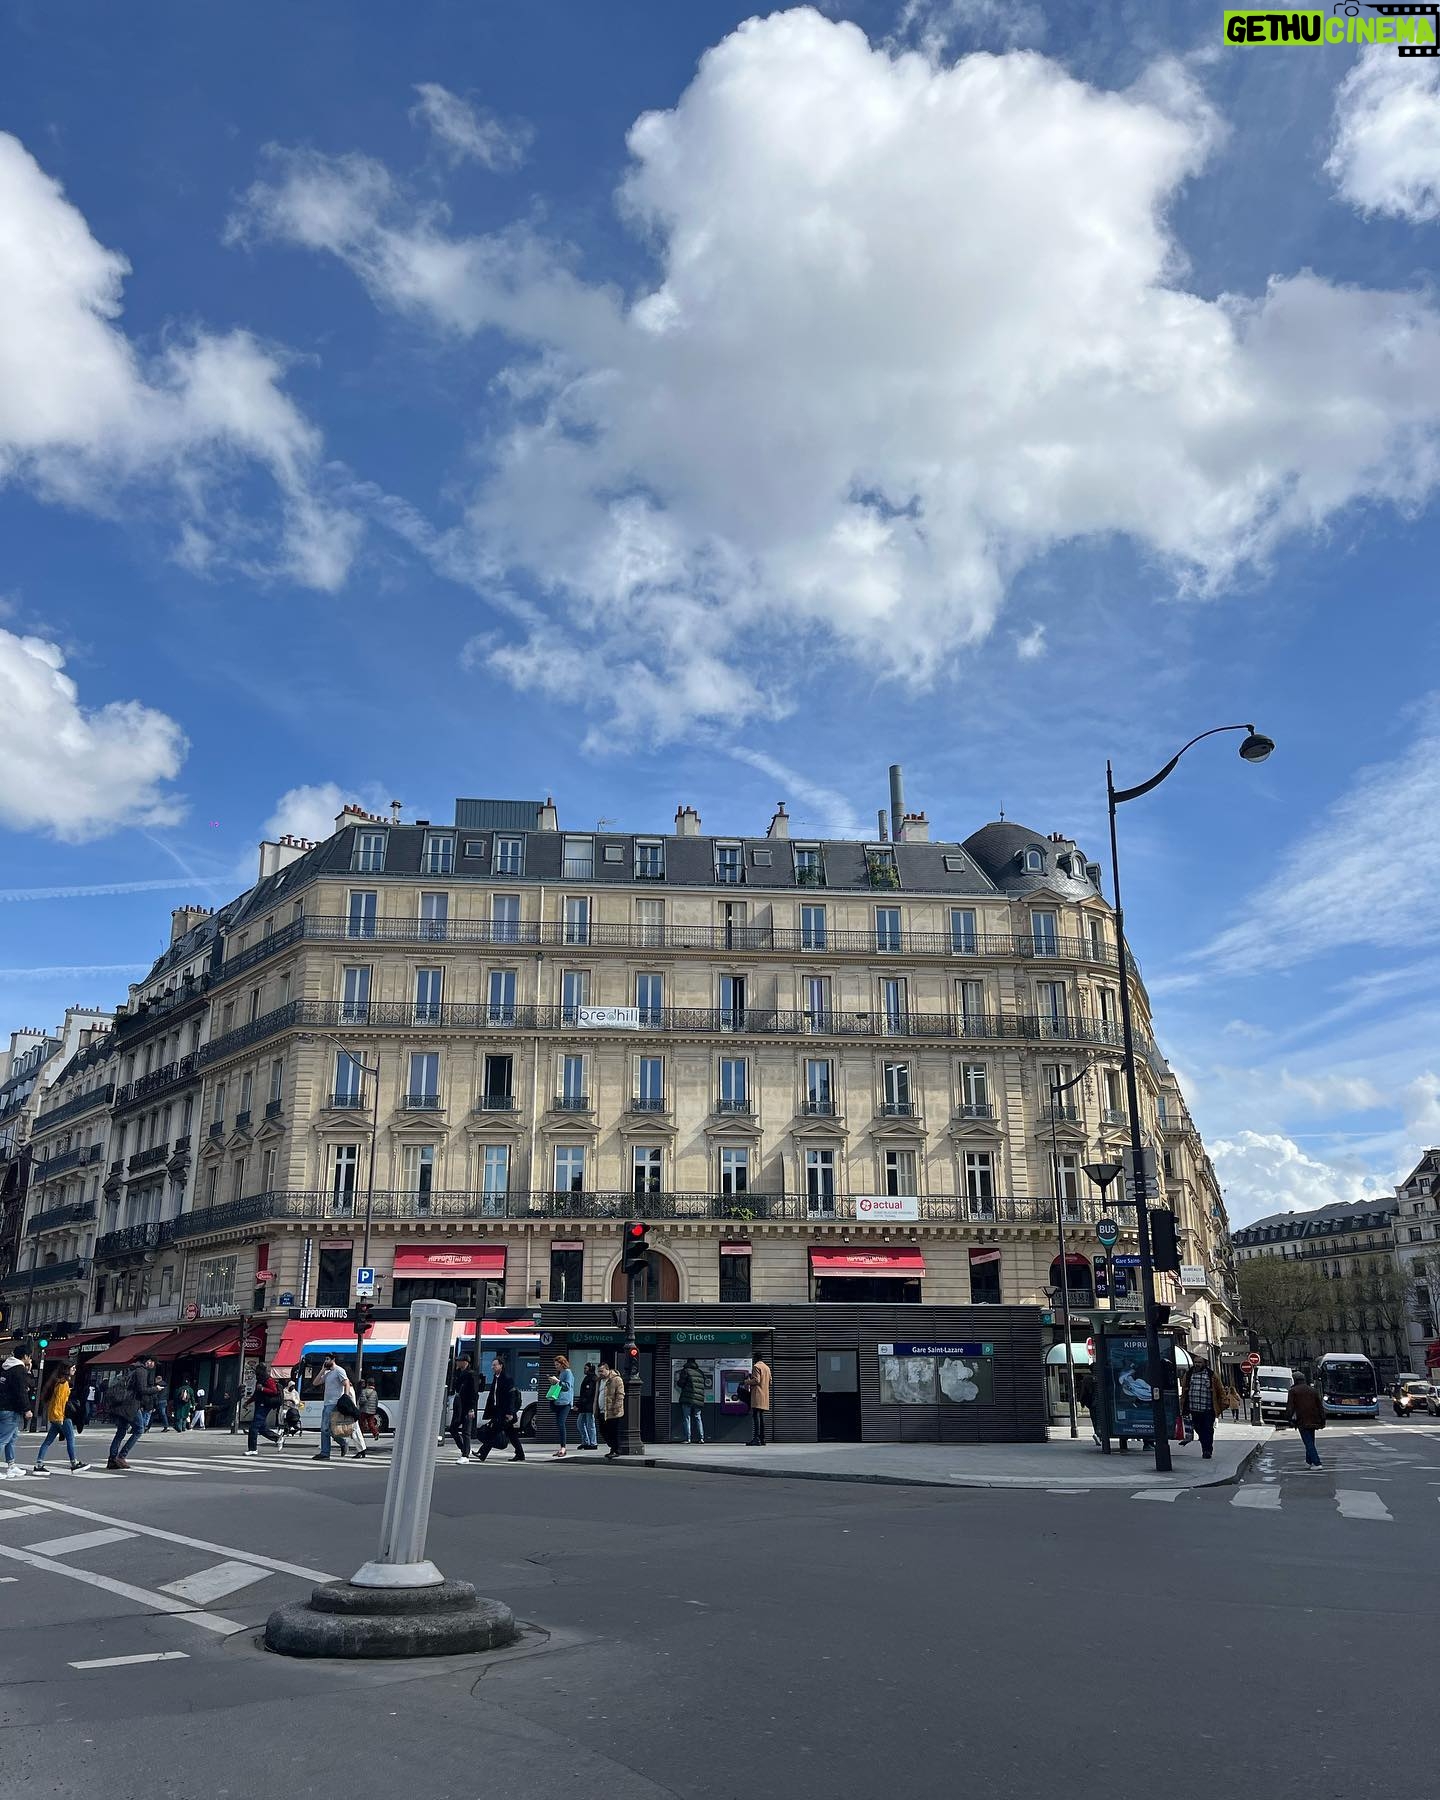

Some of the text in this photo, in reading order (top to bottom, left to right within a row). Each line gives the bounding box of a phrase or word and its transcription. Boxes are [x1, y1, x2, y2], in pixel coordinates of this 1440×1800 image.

[873, 1201, 903, 1209] actual
[1100, 1225, 1116, 1234] BUS
[362, 1270, 370, 1282] P
[300, 1309, 348, 1319] HIPPOPOTAMUS
[687, 1333, 715, 1341] Tickets
